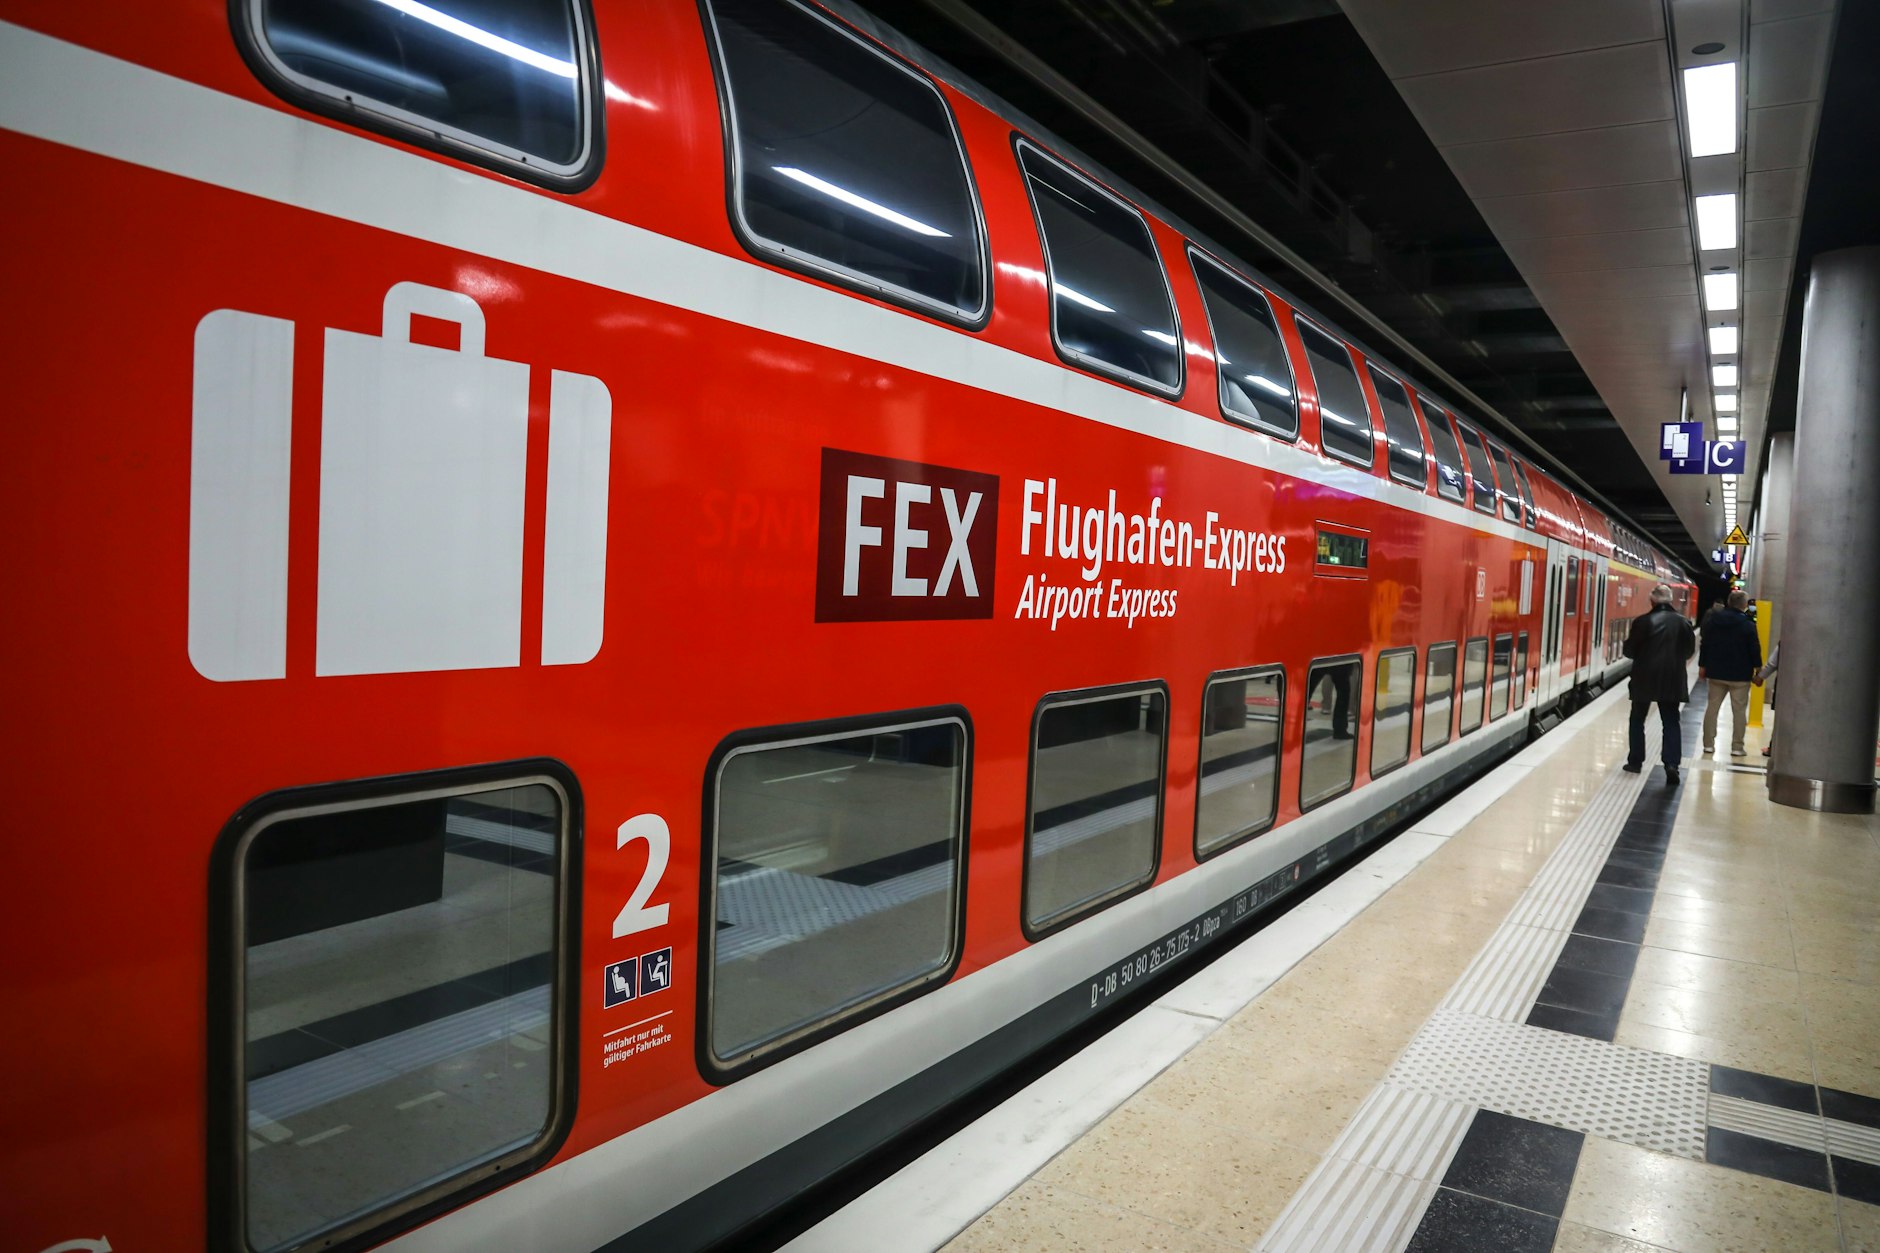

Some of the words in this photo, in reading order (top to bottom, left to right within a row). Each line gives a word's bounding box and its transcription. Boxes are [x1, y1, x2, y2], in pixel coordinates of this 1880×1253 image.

[1711, 441, 1735, 468] C
[842, 474, 984, 598] FEX
[1020, 477, 1287, 587] Flughafen-Express
[1725, 552, 1734, 563] B
[1014, 573, 1104, 631] Airport
[1106, 578, 1178, 629] Express
[612, 813, 671, 939] 2
[1121, 961, 1134, 986] 50
[1135, 953, 1148, 977] 80
[603, 1034, 637, 1054] Mitfahrt
[637, 1030, 650, 1042] nur
[651, 1024, 664, 1037] mit
[603, 1047, 635, 1069] gültiger
[635, 1033, 672, 1054] Fahrkarte
